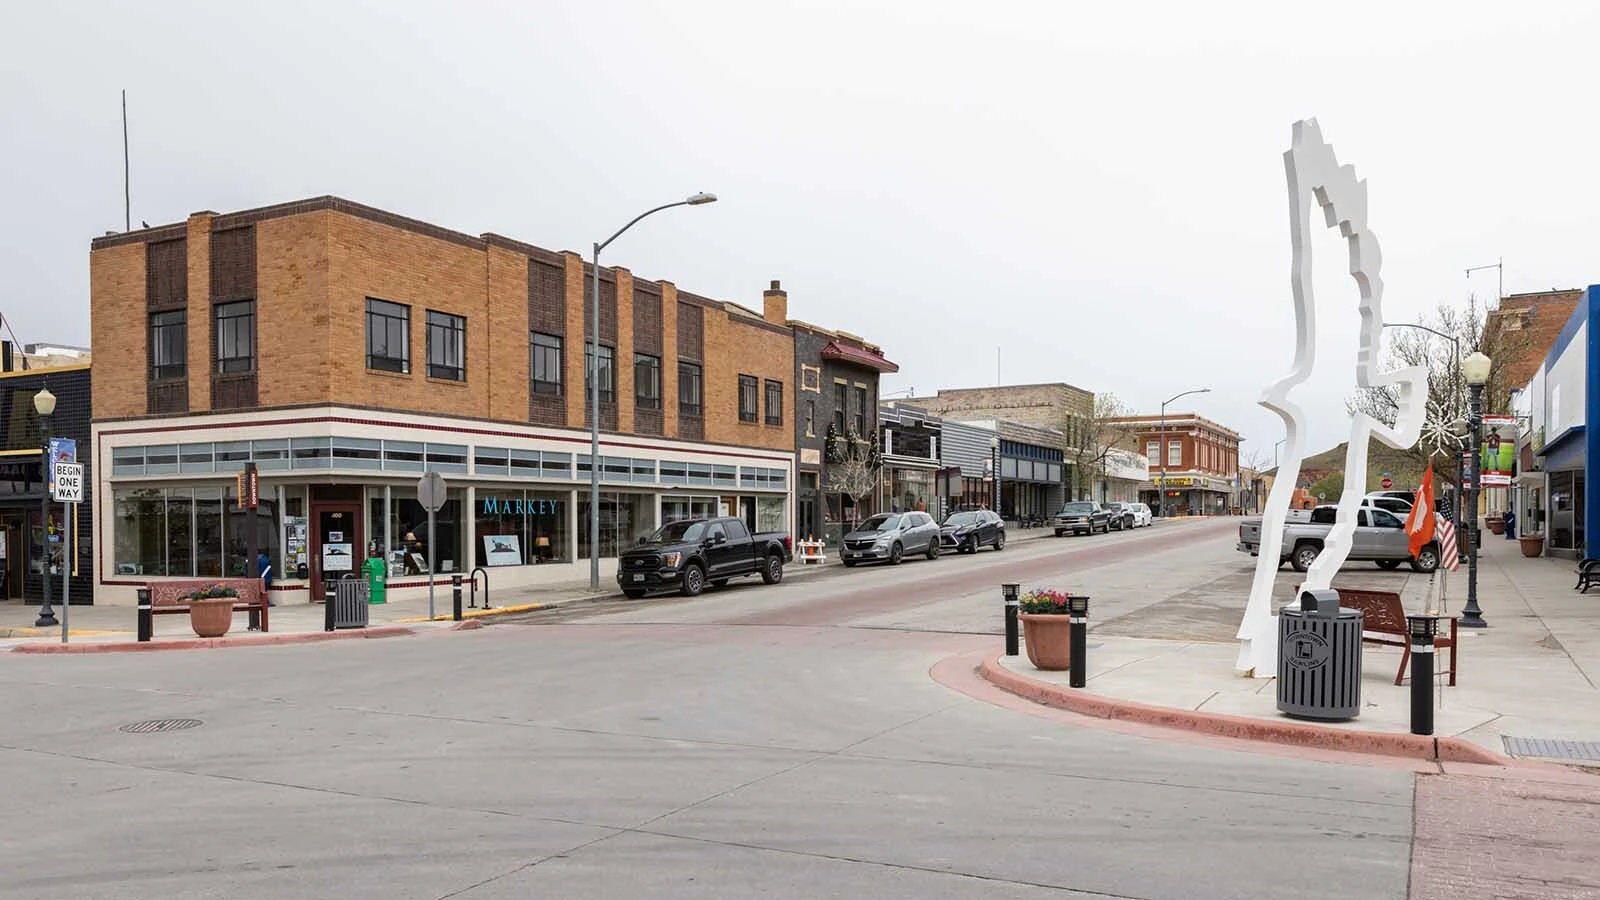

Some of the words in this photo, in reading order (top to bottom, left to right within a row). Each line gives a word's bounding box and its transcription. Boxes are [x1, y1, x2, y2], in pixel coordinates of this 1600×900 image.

[57, 466, 80, 476] BEGIN
[60, 477, 78, 488] ONE
[58, 489, 79, 499] WAY
[483, 495, 557, 515] MARKEY
